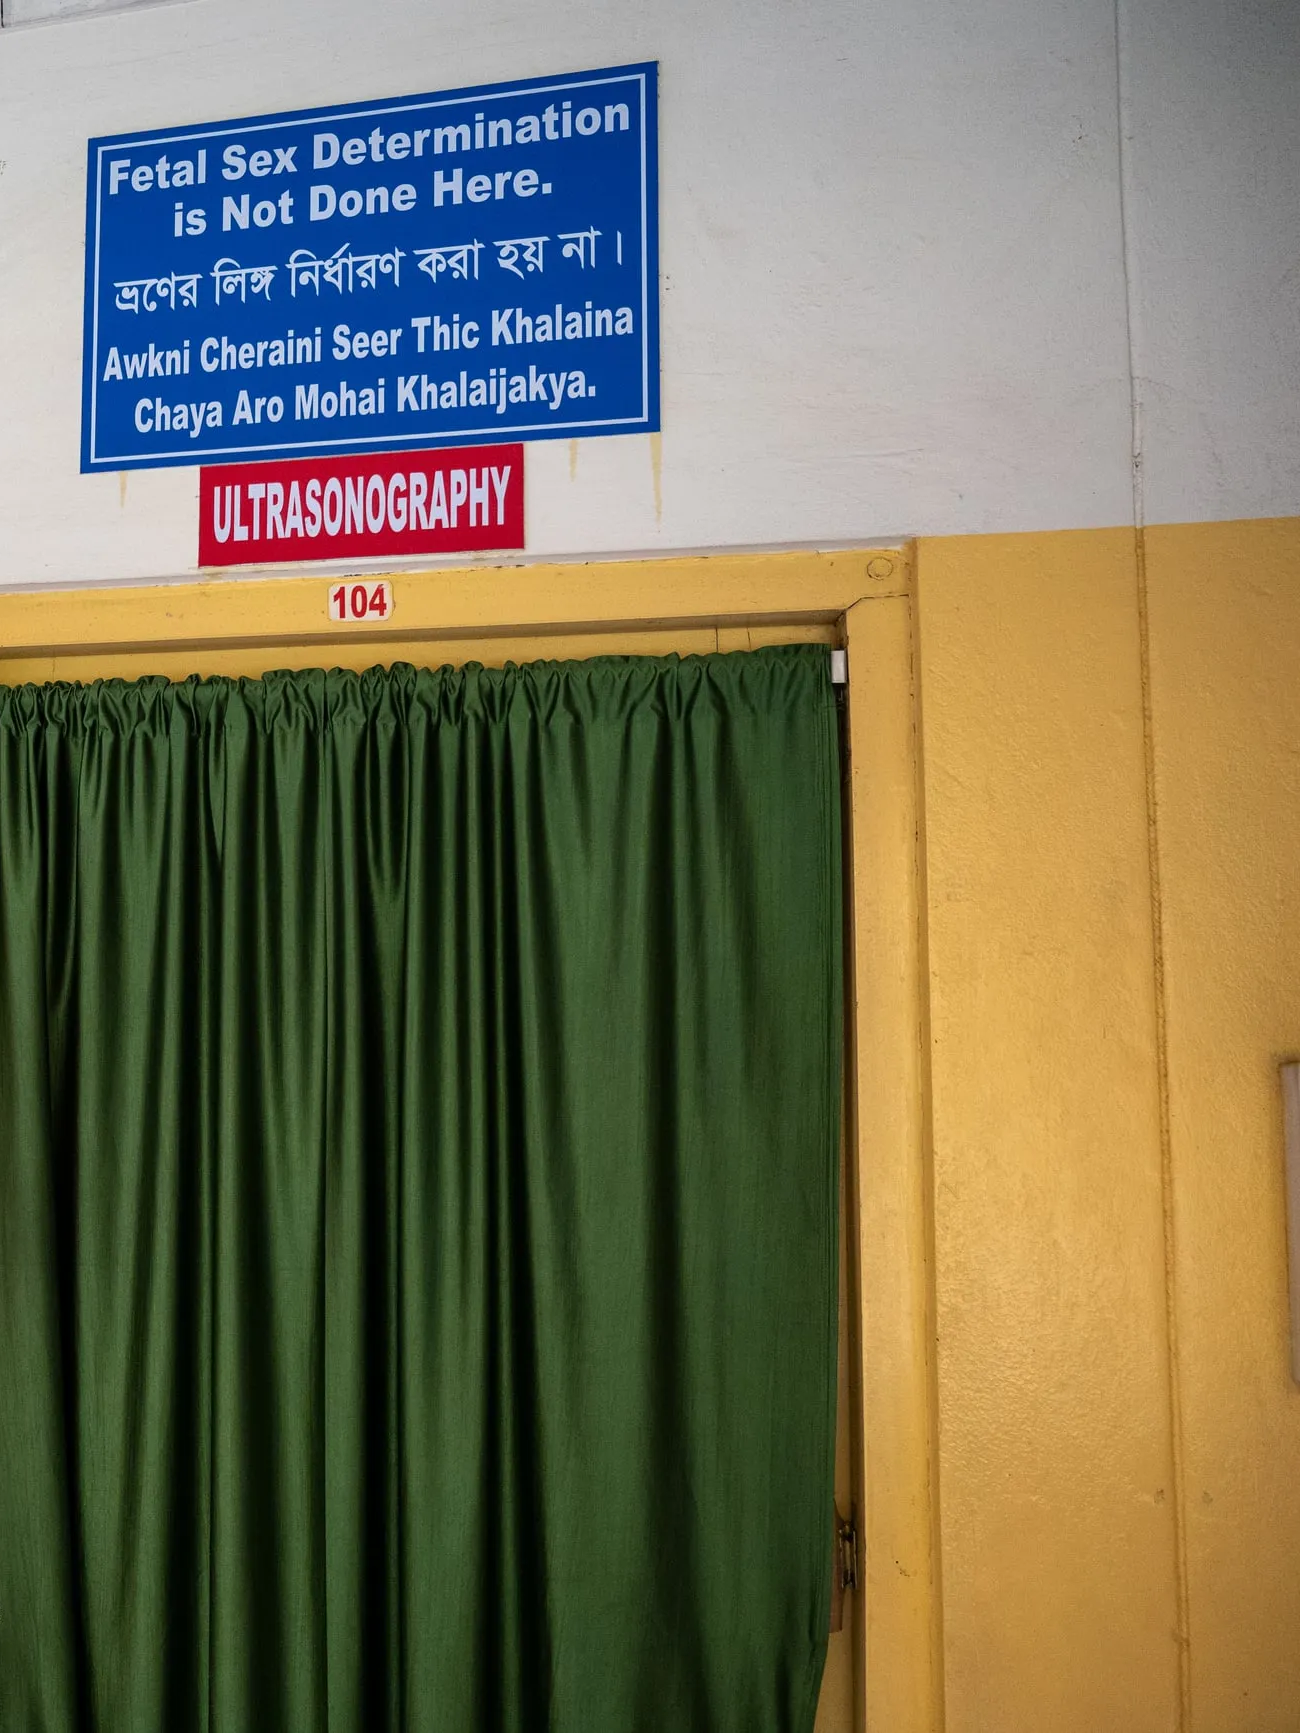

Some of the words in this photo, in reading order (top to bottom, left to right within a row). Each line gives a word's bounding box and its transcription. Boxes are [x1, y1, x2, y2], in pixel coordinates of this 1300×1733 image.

[109, 149, 207, 195] Fetal
[221, 144, 298, 181] Sex
[312, 101, 630, 169] Determination
[174, 202, 207, 237] is
[222, 189, 294, 232] Not
[309, 183, 417, 221] Done
[433, 167, 552, 207] Here.
[209, 257, 278, 306] লিঙ্গ
[285, 242, 407, 298] নির্ধারণ
[413, 238, 485, 283] করা
[493, 236, 550, 280] হয়
[557, 225, 602, 269] না
[103, 339, 190, 382] Awkni
[200, 327, 322, 373] Cheraini
[332, 324, 403, 361] Seer
[411, 313, 480, 353] Thic
[491, 301, 633, 346] Khalaina
[134, 397, 223, 438] Chaya
[232, 390, 284, 425] Aro
[295, 378, 385, 420] Mohai
[397, 365, 596, 414] Khalaijakya.
[213, 465, 512, 544] ULTRASONOGRAPHY
[333, 584, 387, 619] 104
